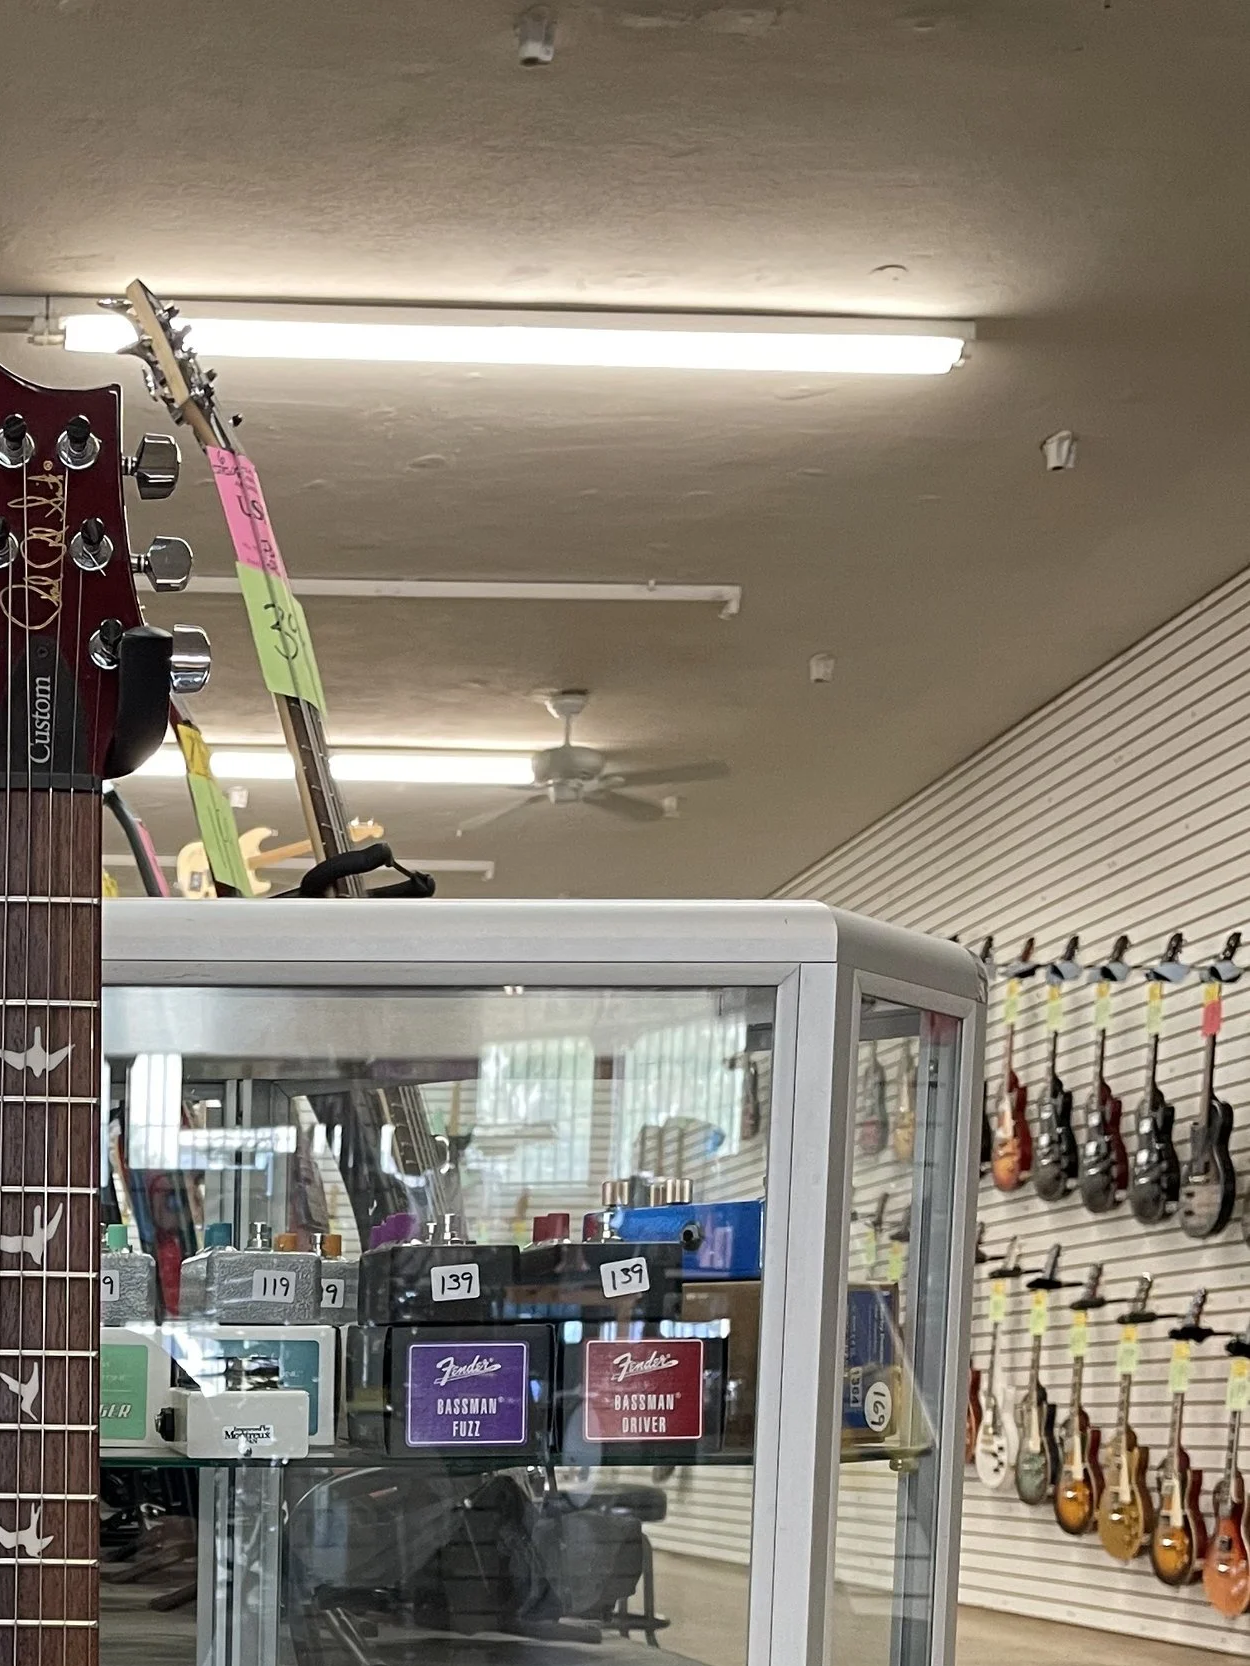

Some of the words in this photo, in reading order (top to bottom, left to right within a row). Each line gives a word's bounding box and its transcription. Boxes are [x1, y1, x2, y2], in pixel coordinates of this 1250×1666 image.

[27, 675, 53, 764] Custom
[263, 1276, 290, 1297] 119
[441, 1271, 473, 1296] 139
[610, 1263, 643, 1291] 139
[434, 1354, 501, 1387] Fender
[611, 1350, 679, 1382] Fender
[437, 1398, 497, 1415] BASSMAN
[614, 1394, 675, 1411] BASSMAN
[871, 1391, 886, 1426] 169
[452, 1421, 481, 1437] FUZZ
[622, 1416, 666, 1433] DRIVER
